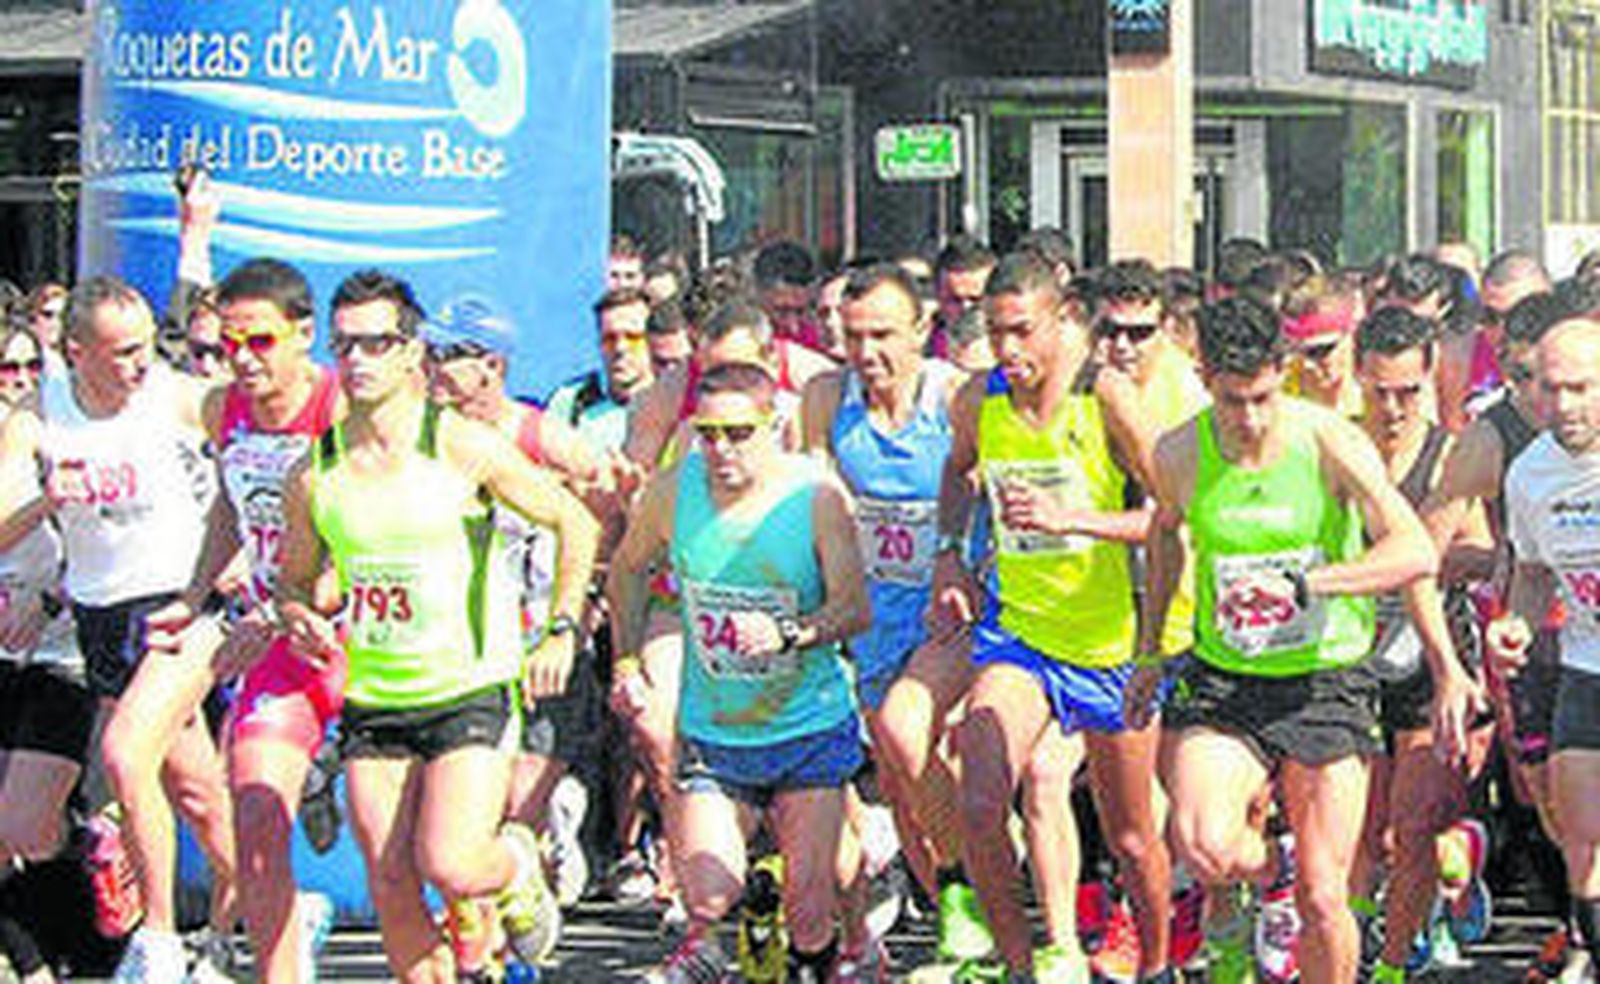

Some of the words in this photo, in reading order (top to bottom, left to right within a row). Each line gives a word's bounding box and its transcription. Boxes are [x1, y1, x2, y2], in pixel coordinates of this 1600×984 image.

[265, 7, 315, 79] de
[328, 5, 440, 86] Mar
[180, 122, 231, 170] del
[248, 123, 407, 181] Deporte
[423, 128, 506, 178] Base
[873, 525, 915, 563] 20
